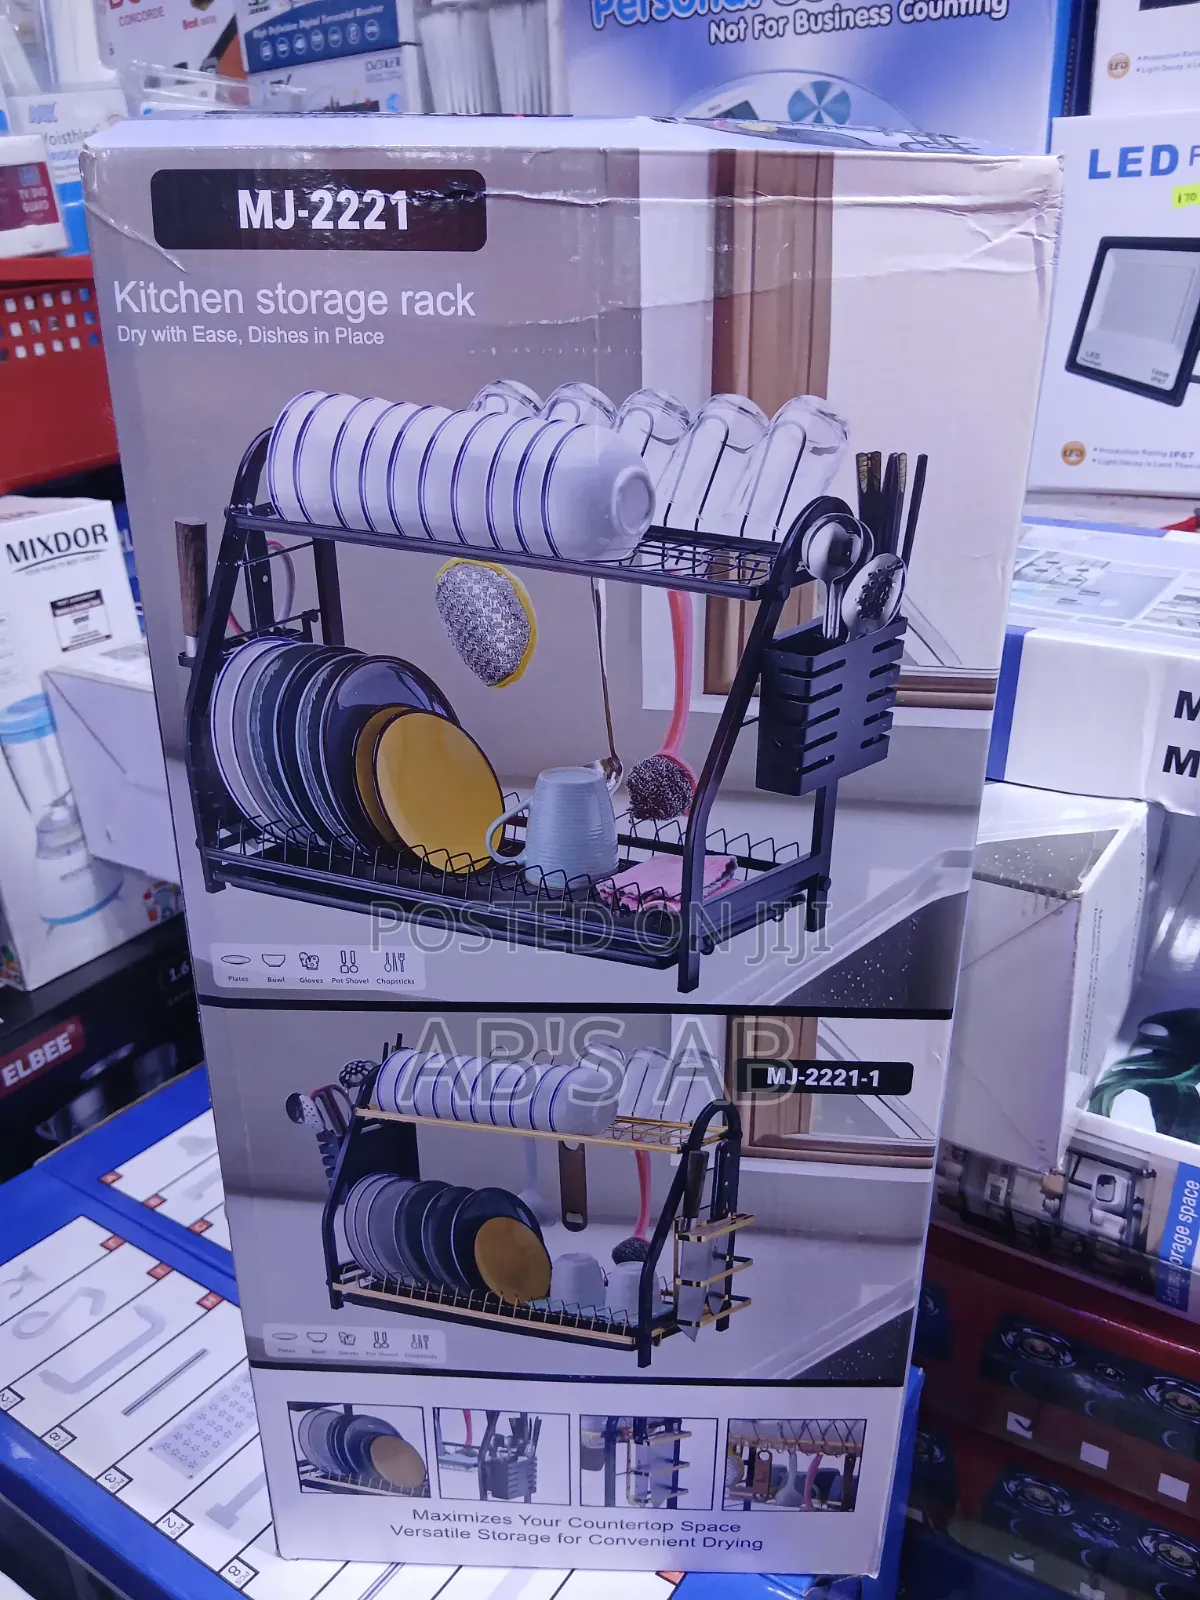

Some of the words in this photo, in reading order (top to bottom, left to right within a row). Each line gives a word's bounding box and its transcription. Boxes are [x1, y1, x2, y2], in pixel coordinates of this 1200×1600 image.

[708, 16, 748, 45] Not
[752, 14, 789, 40] For
[793, 3, 892, 35] Business
[897, 0, 1009, 23] Counting
[1088, 144, 1180, 180] LED
[237, 189, 409, 231] MJ-2221
[113, 280, 245, 315] Kitchen
[255, 282, 389, 324] storage
[401, 283, 476, 317] rack
[117, 325, 147, 345] Dry
[152, 326, 188, 343] with
[193, 326, 243, 347] Ease,
[248, 326, 310, 345] Dishes
[314, 327, 330, 344] in
[335, 327, 385, 346] Place
[1169, 451, 1195, 459] IP67
[5, 523, 109, 565] MIXDOR
[1, 1032, 73, 1088] ELBEE
[766, 1067, 880, 1087] MJ-2221-1
[1178, 1179, 1200, 1224] space
[104, 1473, 117, 1484] 3
[162, 1517, 177, 1529] 2
[412, 1508, 513, 1526] Maximizes
[518, 1514, 562, 1528] Your
[568, 1516, 675, 1534] Countertop
[680, 1520, 742, 1534] Space
[389, 1524, 472, 1540] Versatile
[477, 1528, 551, 1546] Storage
[557, 1533, 583, 1545] for
[588, 1533, 697, 1548] Convenient
[702, 1536, 764, 1551] Drying
[227, 1565, 241, 1577] 8
